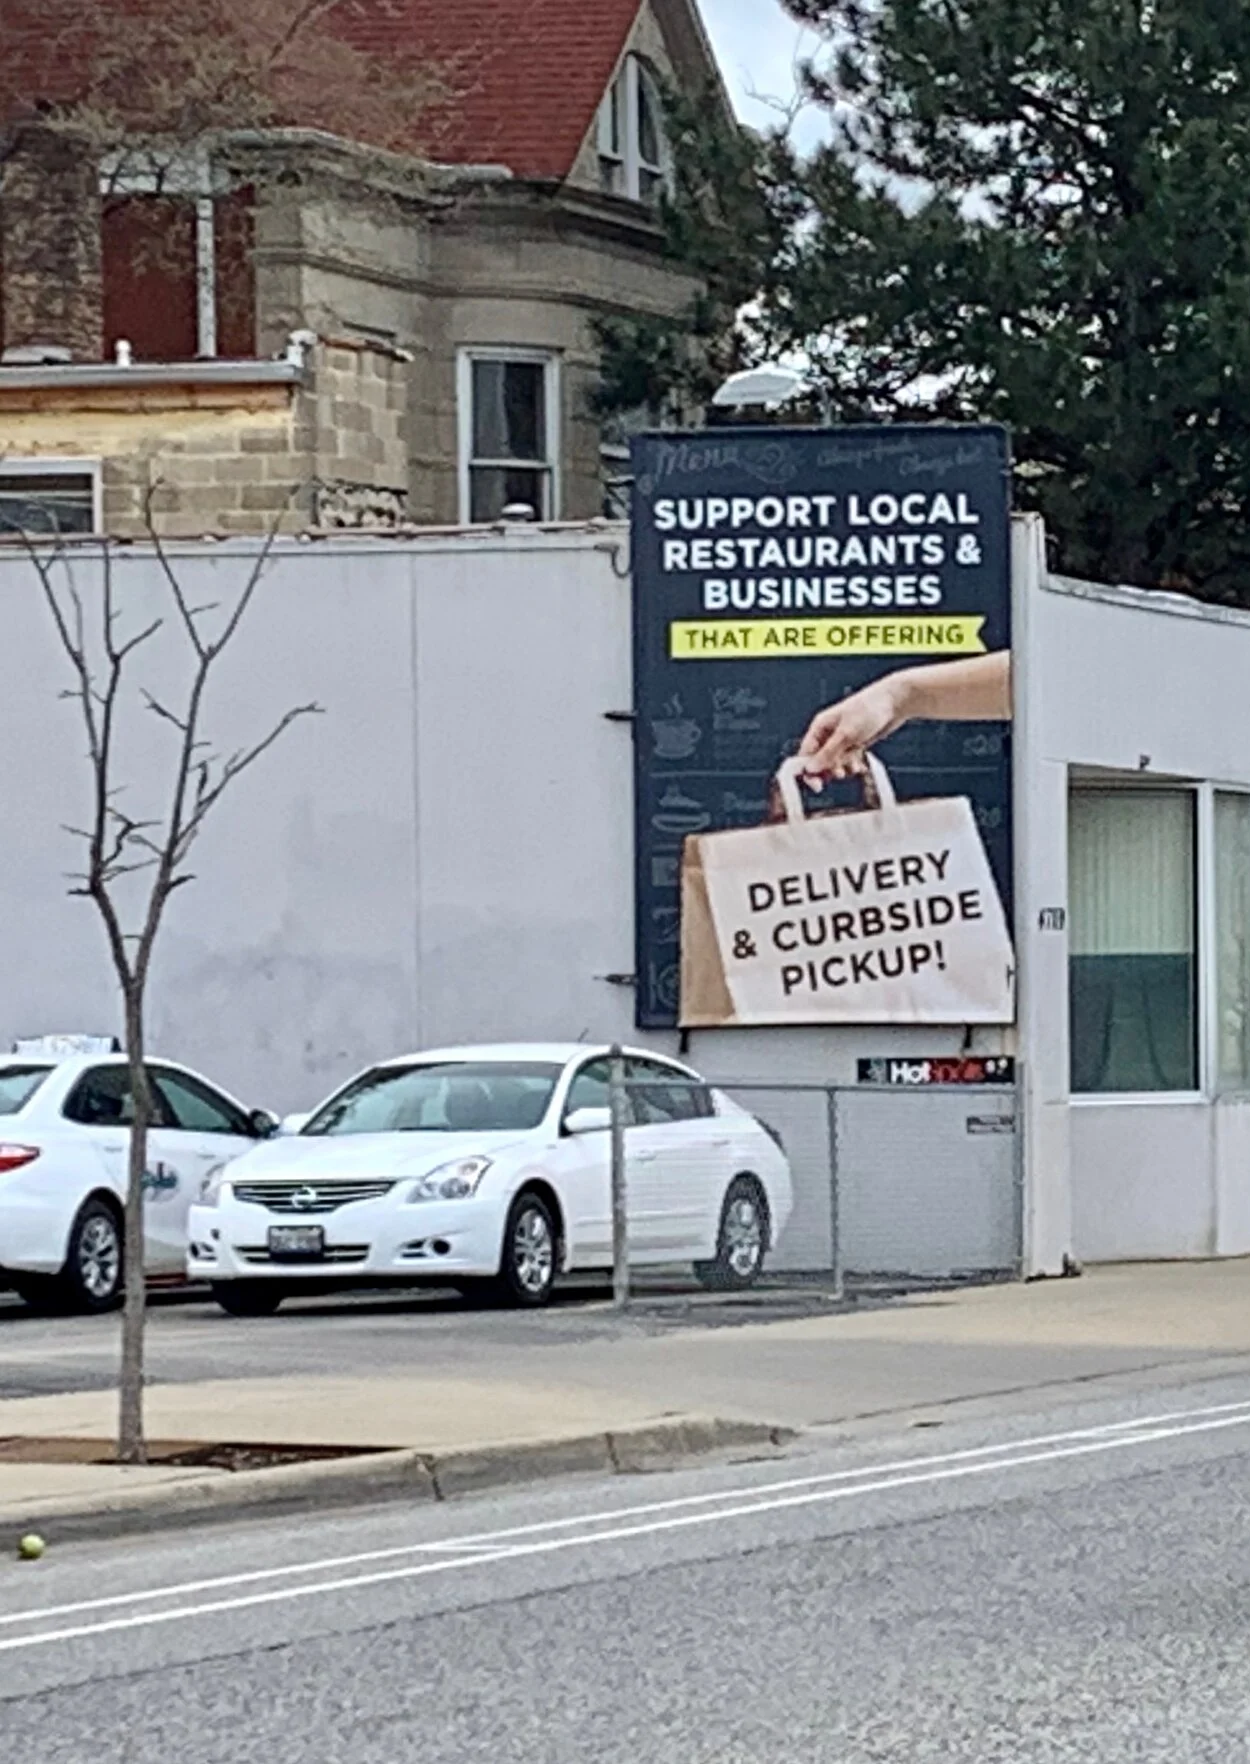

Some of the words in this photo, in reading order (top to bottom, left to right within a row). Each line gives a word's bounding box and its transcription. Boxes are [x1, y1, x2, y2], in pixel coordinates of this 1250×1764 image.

[654, 495, 837, 530] SUPPORT
[848, 493, 979, 525] LOCAL
[664, 534, 945, 571] RESTAURANTS
[956, 533, 982, 565] &
[704, 575, 942, 610] BUSINESSES
[686, 628, 752, 650] THAT
[763, 627, 817, 648] ARE
[826, 623, 965, 647] OFFERING
[747, 850, 951, 912] DELIVERY
[731, 930, 758, 960] &
[771, 889, 983, 953] CURBSIDE
[780, 940, 948, 996] PICKUP!
